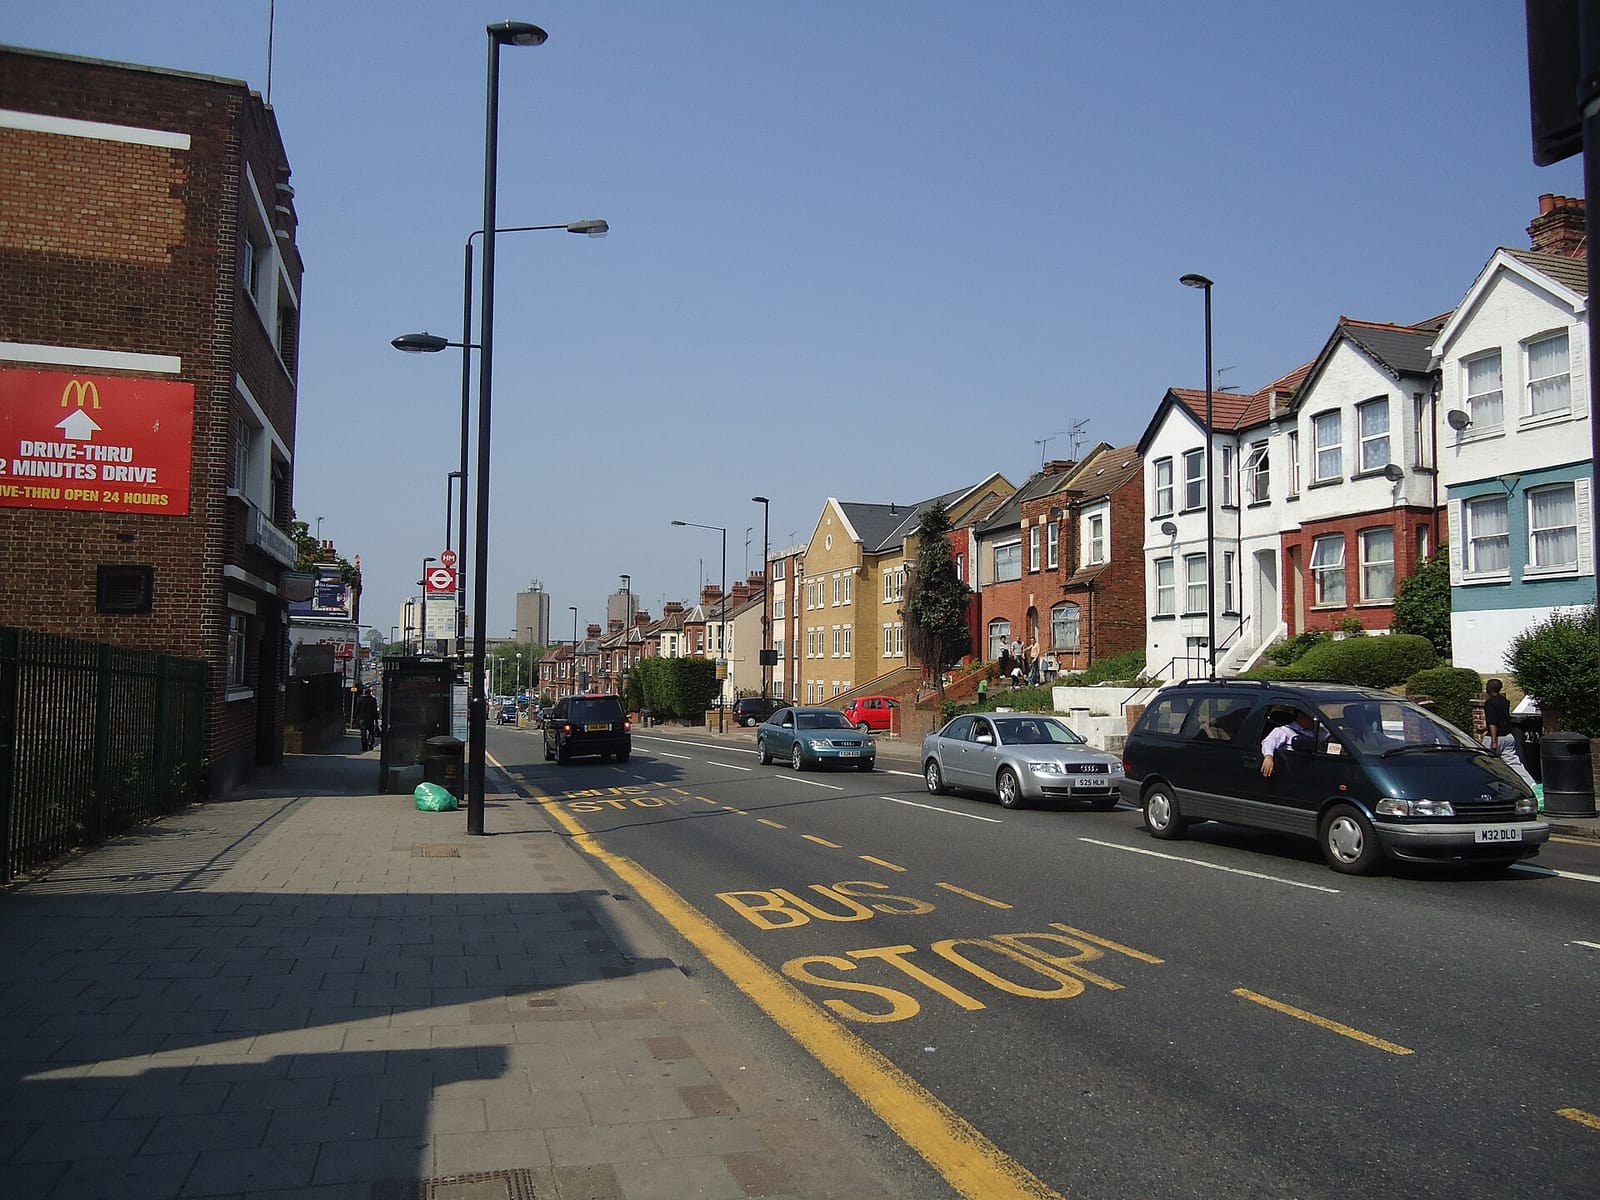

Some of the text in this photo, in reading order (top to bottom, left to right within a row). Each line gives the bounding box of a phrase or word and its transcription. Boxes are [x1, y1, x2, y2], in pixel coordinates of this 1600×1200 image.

[20, 440, 133, 463] DRIVE-THRU
[12, 459, 97, 480] MINUTES
[102, 464, 157, 483] DRIVE
[64, 488, 99, 502] OPEN
[103, 491, 120, 503] 24
[124, 492, 169, 506] HOURS
[562, 785, 650, 798] BUS
[1481, 829, 1516, 841] M32 DLO
[715, 880, 936, 930] BUS
[781, 932, 1126, 1024] STOP
